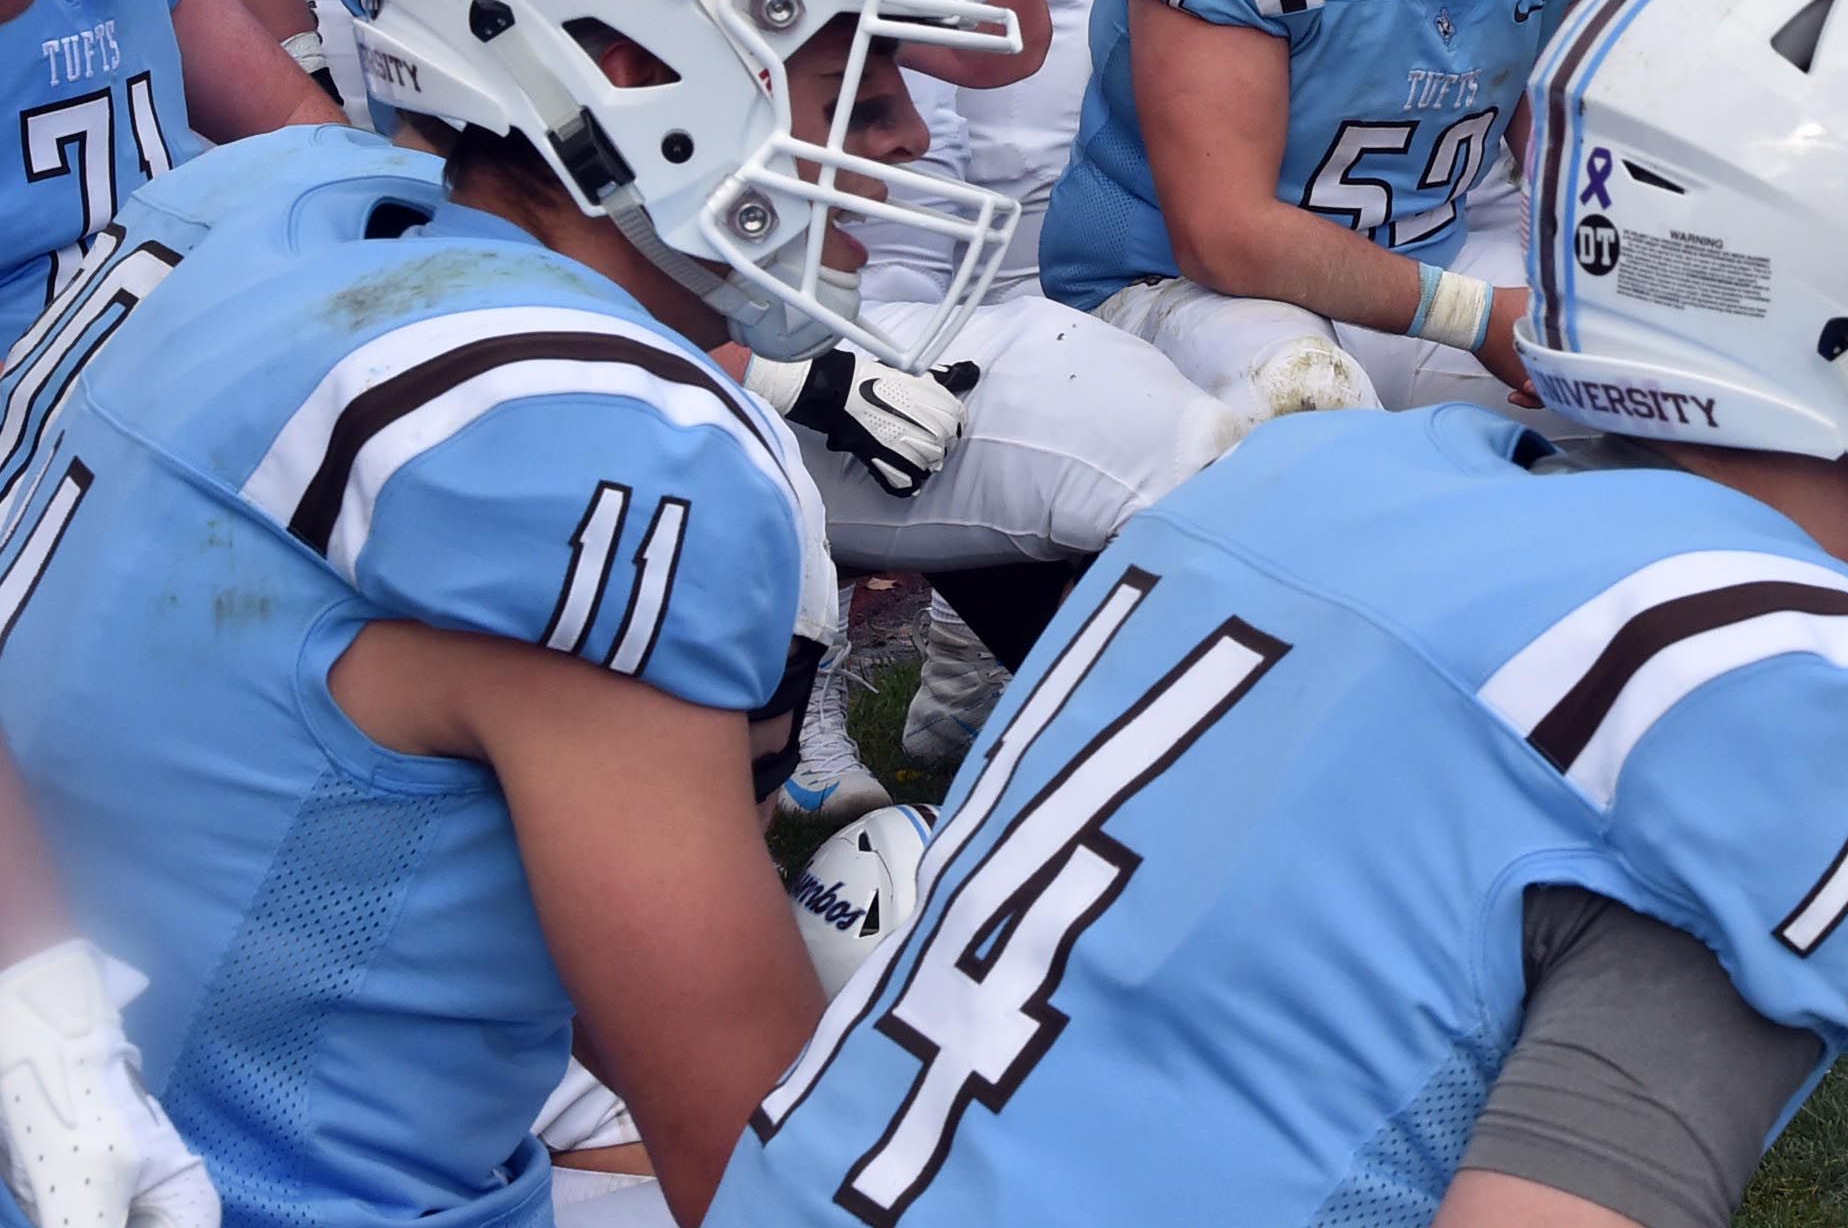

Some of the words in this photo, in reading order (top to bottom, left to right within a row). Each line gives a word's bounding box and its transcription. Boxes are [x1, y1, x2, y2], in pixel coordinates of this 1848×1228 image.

[42, 20, 121, 87] TUFTS
[1403, 69, 1482, 109] TUFTS
[1299, 106, 1499, 248] 52
[1579, 226, 1615, 266] DT
[1670, 229, 1724, 250] WARNING
[544, 479, 692, 676] 11
[749, 564, 1294, 1228] 14
